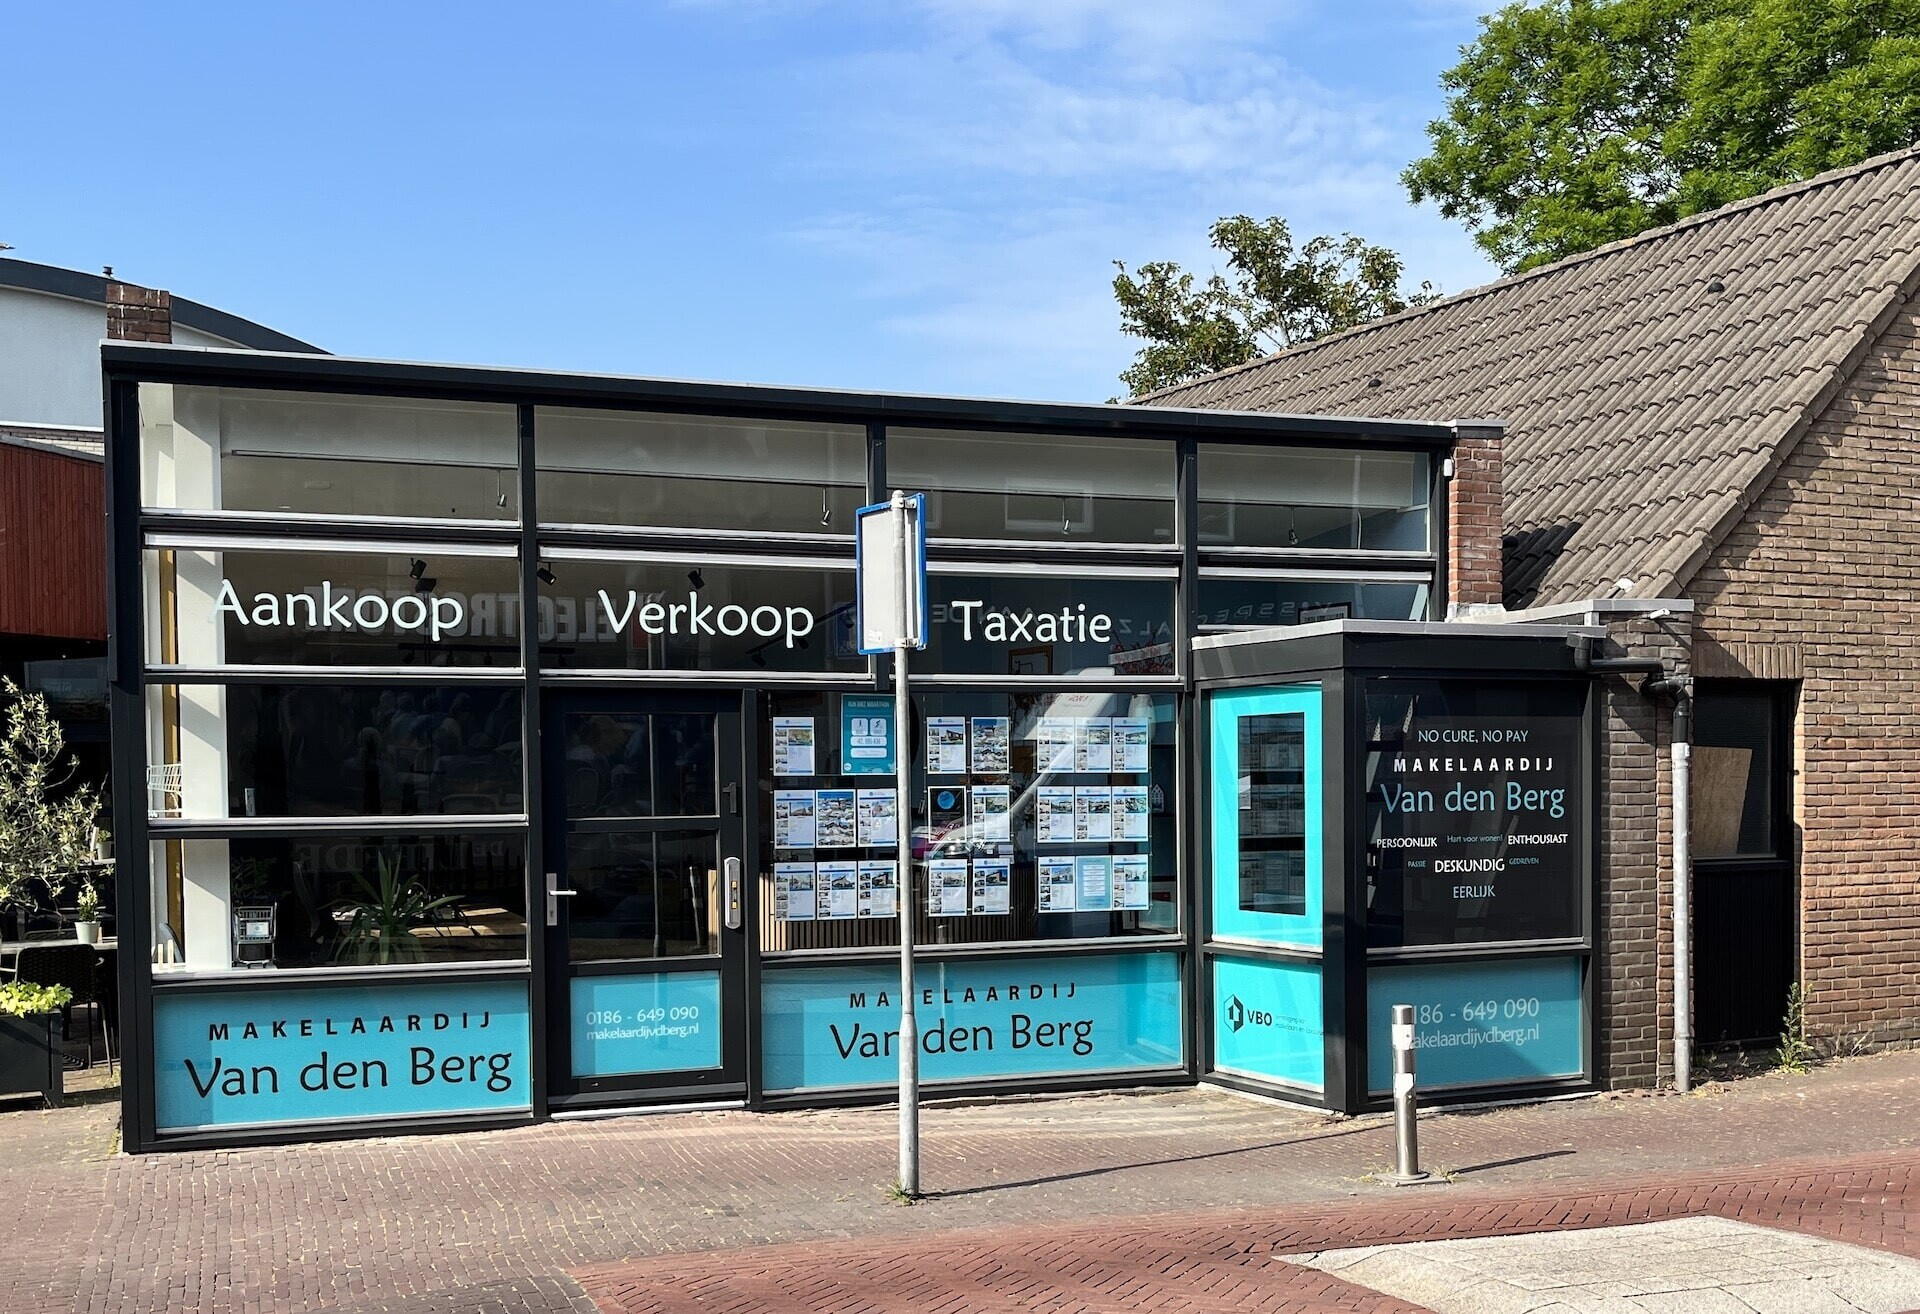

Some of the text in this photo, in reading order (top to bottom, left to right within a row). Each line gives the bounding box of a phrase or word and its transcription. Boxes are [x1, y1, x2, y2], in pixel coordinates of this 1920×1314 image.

[210, 579, 463, 642] Aankoop
[598, 590, 814, 648] Verkoop
[952, 601, 1112, 642] Taxatie
[1418, 729, 1529, 744] NO CURE, NO PAY
[1393, 757, 1553, 772] MAKELAARDIJ
[1380, 781, 1565, 819] Van den Berg
[1376, 837, 1438, 849] PERSOONLIJK
[1507, 833, 1569, 845] ENTHOUSIAST
[1434, 858, 1506, 873] DESKUNDIG
[1452, 885, 1496, 899] EERLIJK
[849, 982, 1075, 1008] MAELAARDIJ
[586, 1010, 622, 1025] 0186
[637, 1008, 665, 1022] 649
[670, 1006, 699, 1020] 090
[1247, 1009, 1273, 1027] VBO
[1412, 1004, 1443, 1024] 186
[1462, 1001, 1498, 1021] 649
[1503, 998, 1540, 1019] 090
[209, 1011, 490, 1041] MAKELAARDIJ
[586, 1022, 699, 1040] makelaardijvdberg.nl
[922, 1017, 993, 1054] den
[1011, 1014, 1094, 1056] Berg
[1412, 1023, 1540, 1049] akelaardijvdberg.nl
[184, 1046, 512, 1098] Van den Berg
